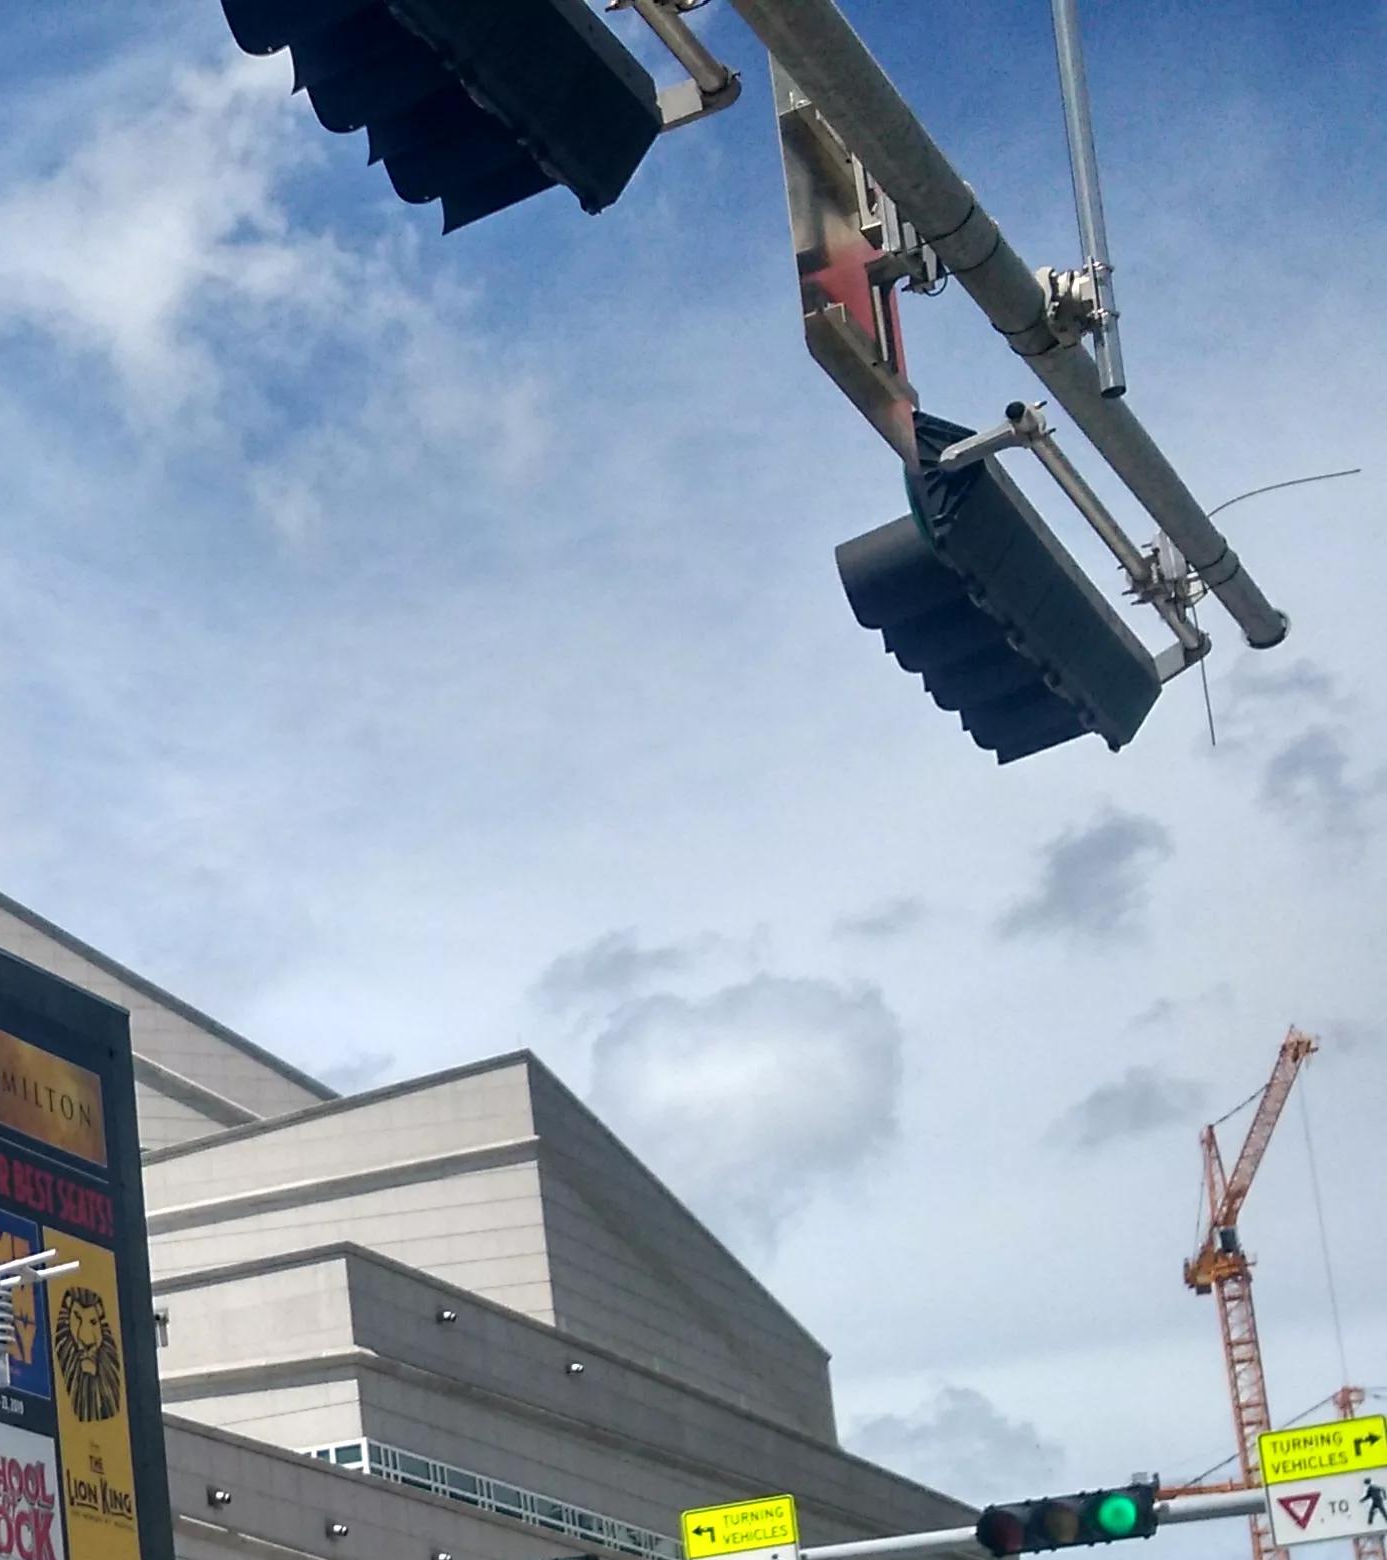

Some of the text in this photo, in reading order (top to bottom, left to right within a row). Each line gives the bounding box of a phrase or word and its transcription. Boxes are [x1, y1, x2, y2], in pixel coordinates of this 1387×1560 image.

[13, 1159, 53, 1214] BEST
[56, 1172, 114, 1238] SEATS!
[1270, 1431, 1343, 1455] TURNING
[1272, 1451, 1348, 1474] VEHICLES
[67, 1468, 99, 1512] LION
[100, 1476, 133, 1519] KING
[723, 1506, 784, 1528] TURNING
[1329, 1500, 1349, 1514] TO
[723, 1525, 789, 1544] VEHICLES
